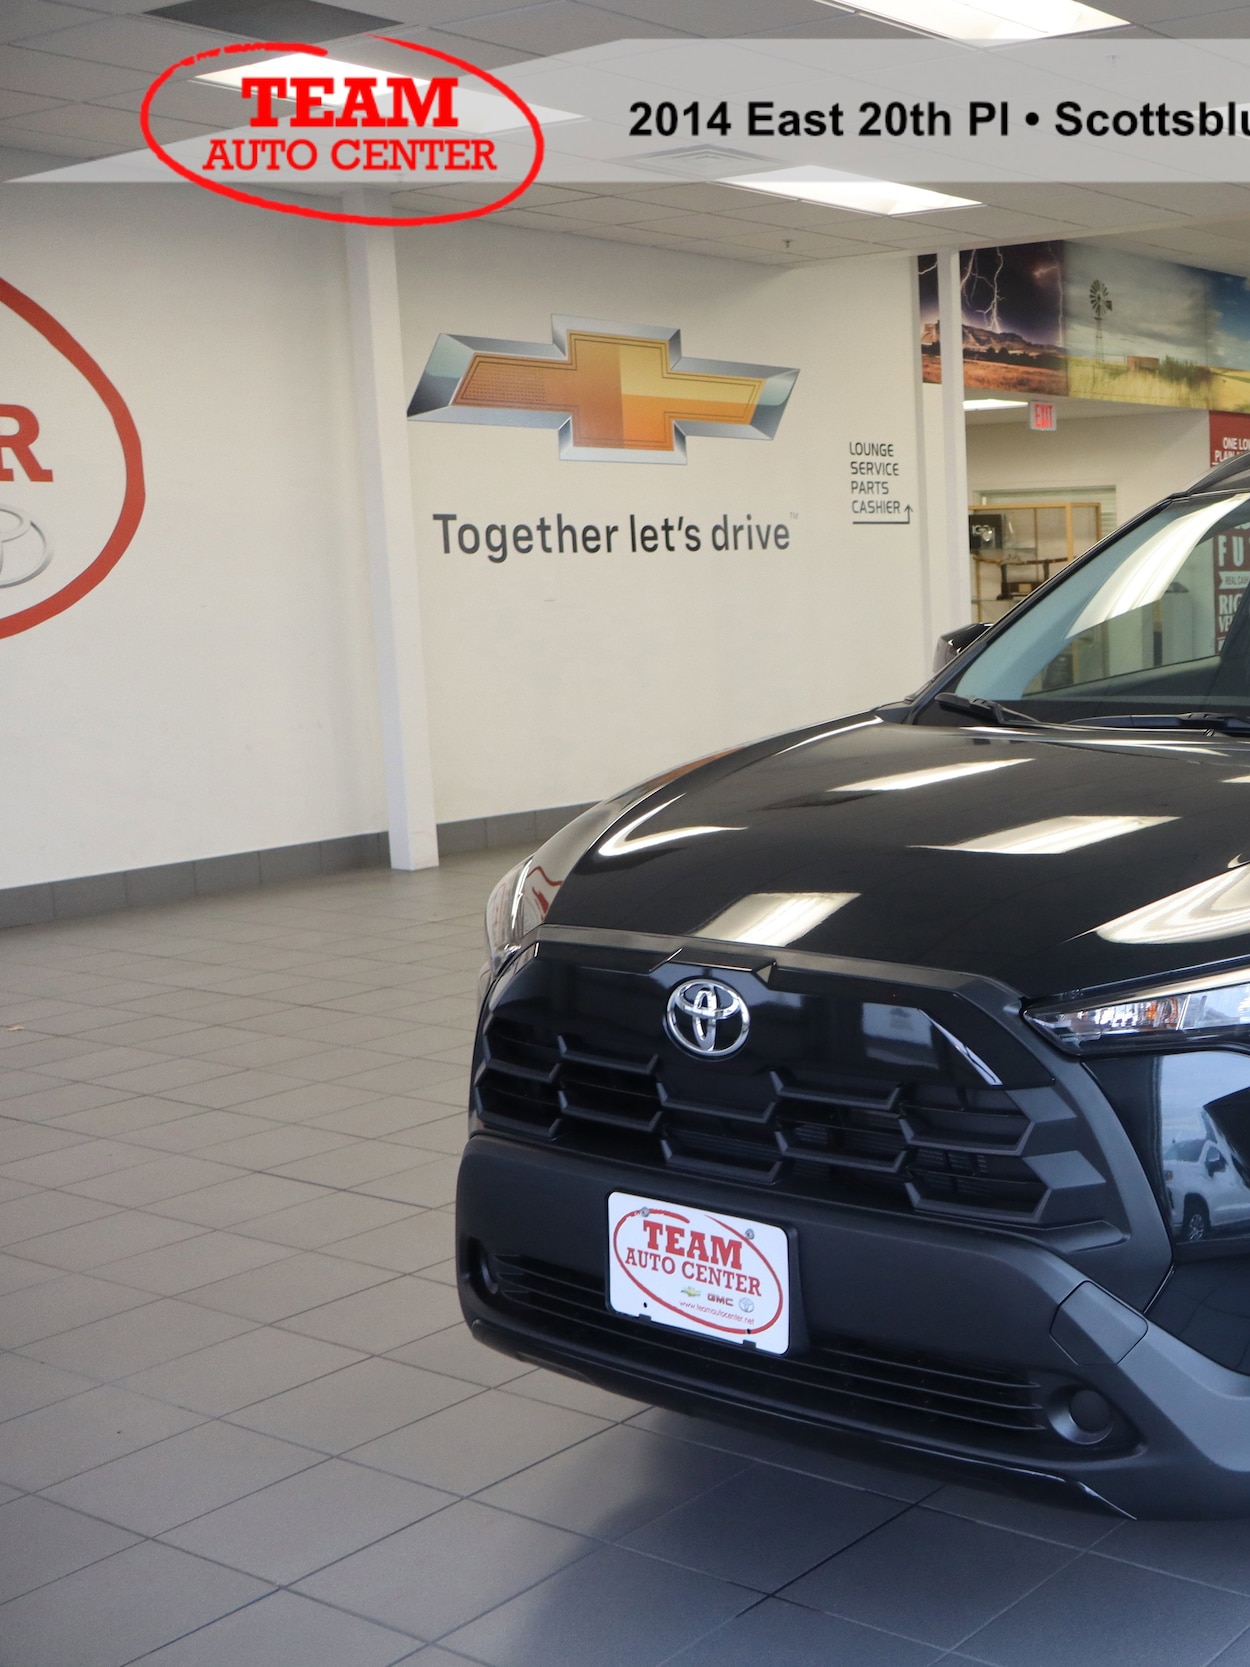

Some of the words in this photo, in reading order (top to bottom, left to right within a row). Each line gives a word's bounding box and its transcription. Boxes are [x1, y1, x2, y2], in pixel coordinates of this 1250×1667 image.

[1034, 404, 1053, 427] EXIT
[849, 441, 895, 457] LOUNGE
[1223, 437, 1238, 450] ONE
[850, 461, 900, 476] SERVICE
[850, 480, 890, 495] PARTS
[851, 499, 901, 514] CASHIER
[432, 513, 619, 564] Together
[629, 513, 702, 553] let's
[711, 513, 790, 551] drive
[643, 1219, 743, 1271] TEAM
[625, 1247, 676, 1275] AUTO
[681, 1260, 762, 1297] CENTER
[707, 1293, 734, 1307] GMC
